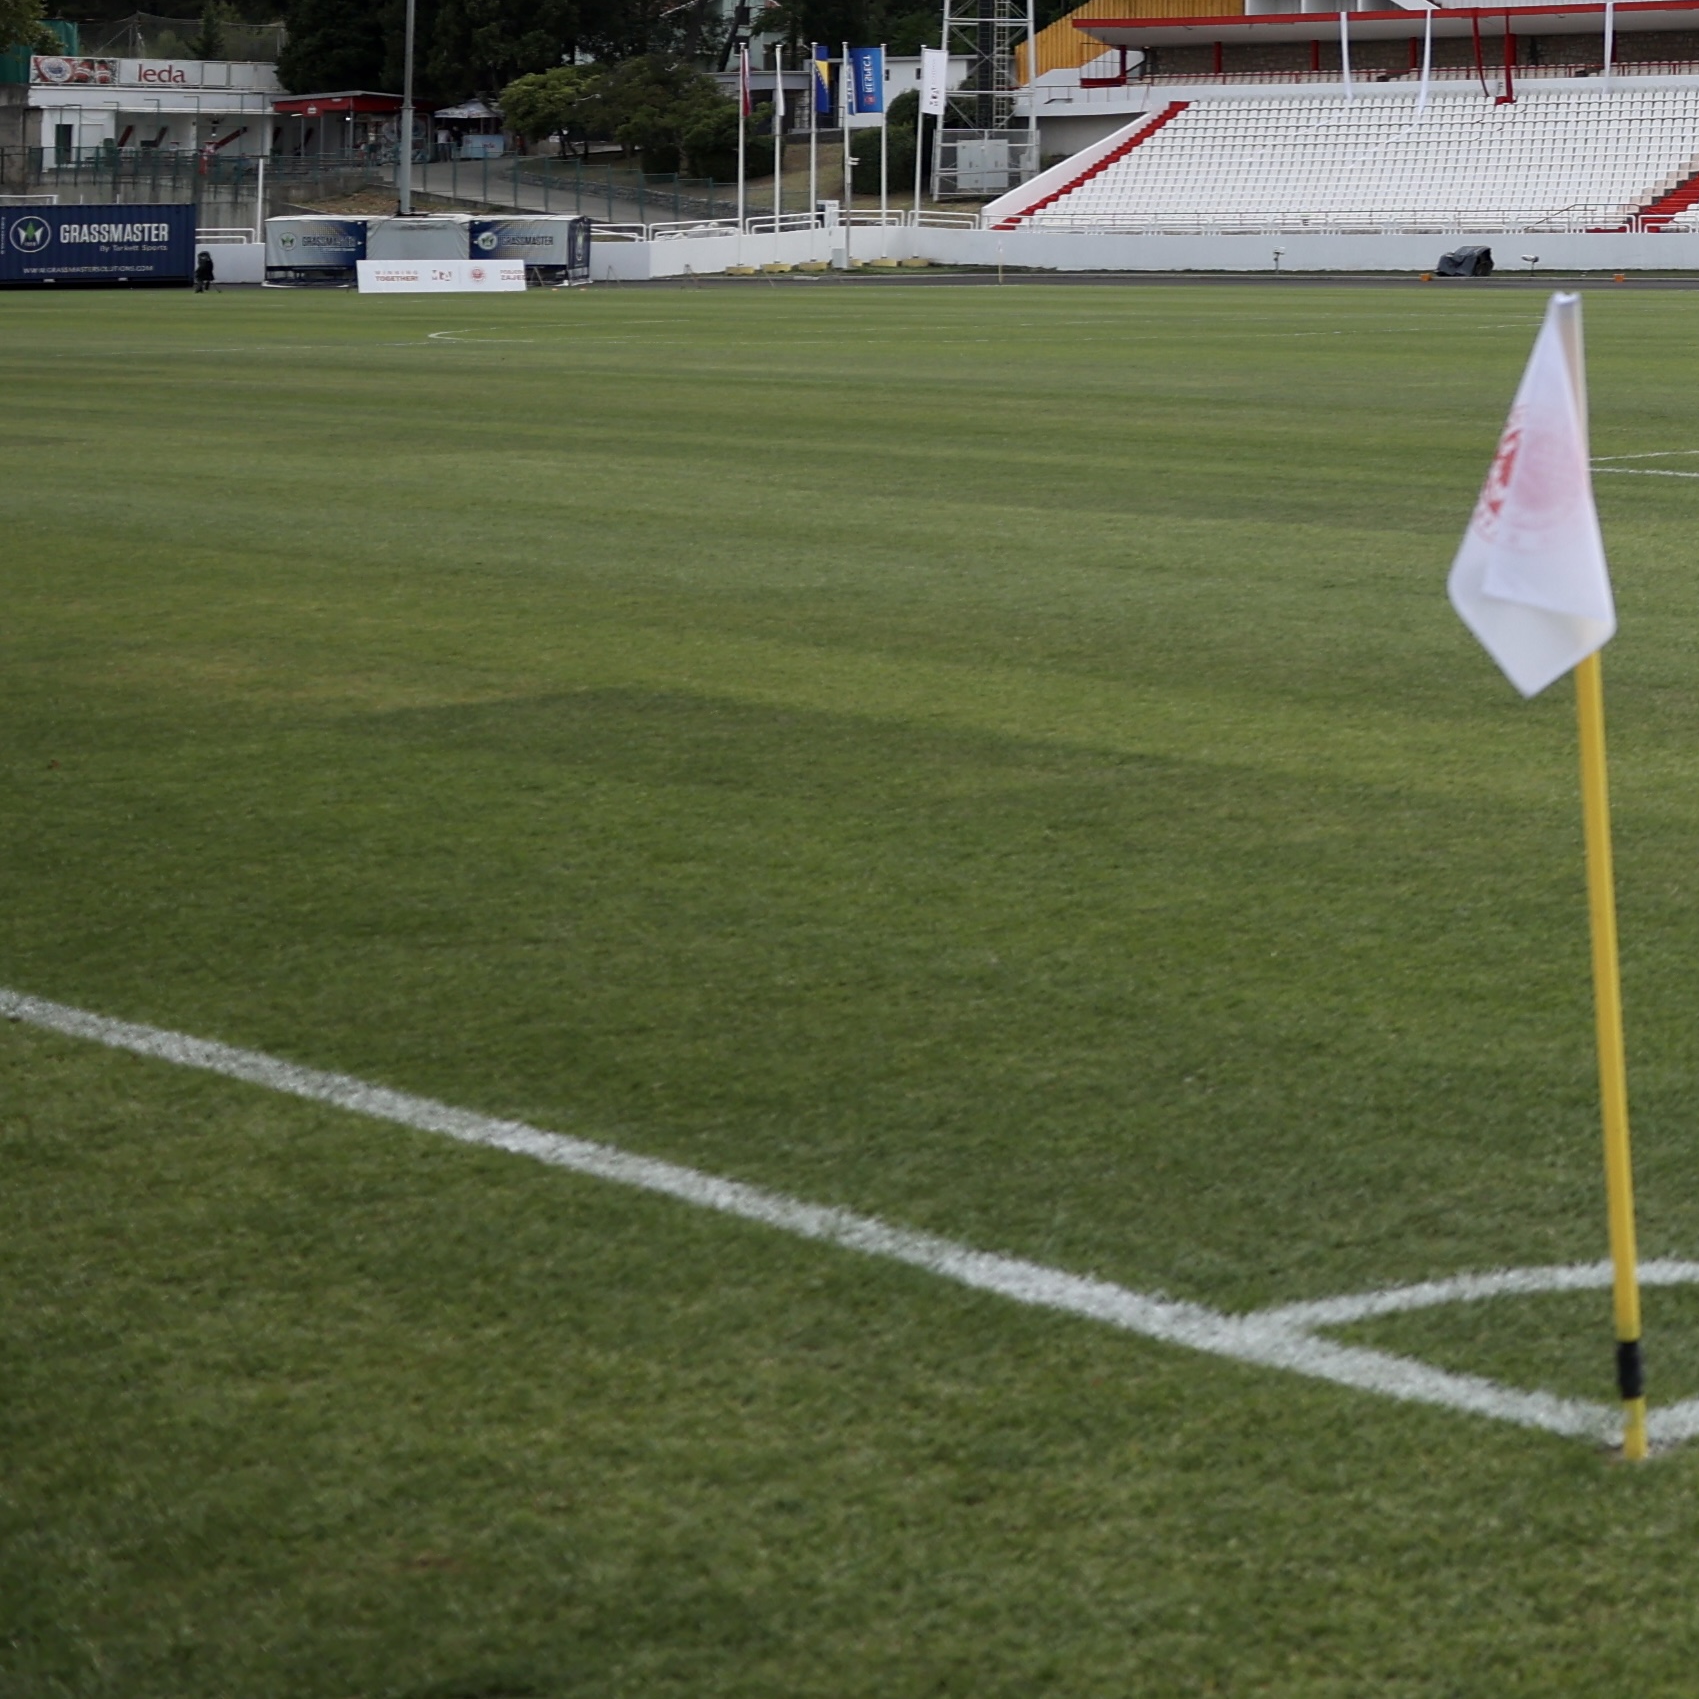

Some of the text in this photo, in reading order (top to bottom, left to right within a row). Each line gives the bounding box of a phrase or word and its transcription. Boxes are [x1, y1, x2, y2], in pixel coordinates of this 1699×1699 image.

[137, 64, 186, 83] leda
[60, 223, 170, 243] GRASSMASTER
[142, 244, 168, 252] Sports
